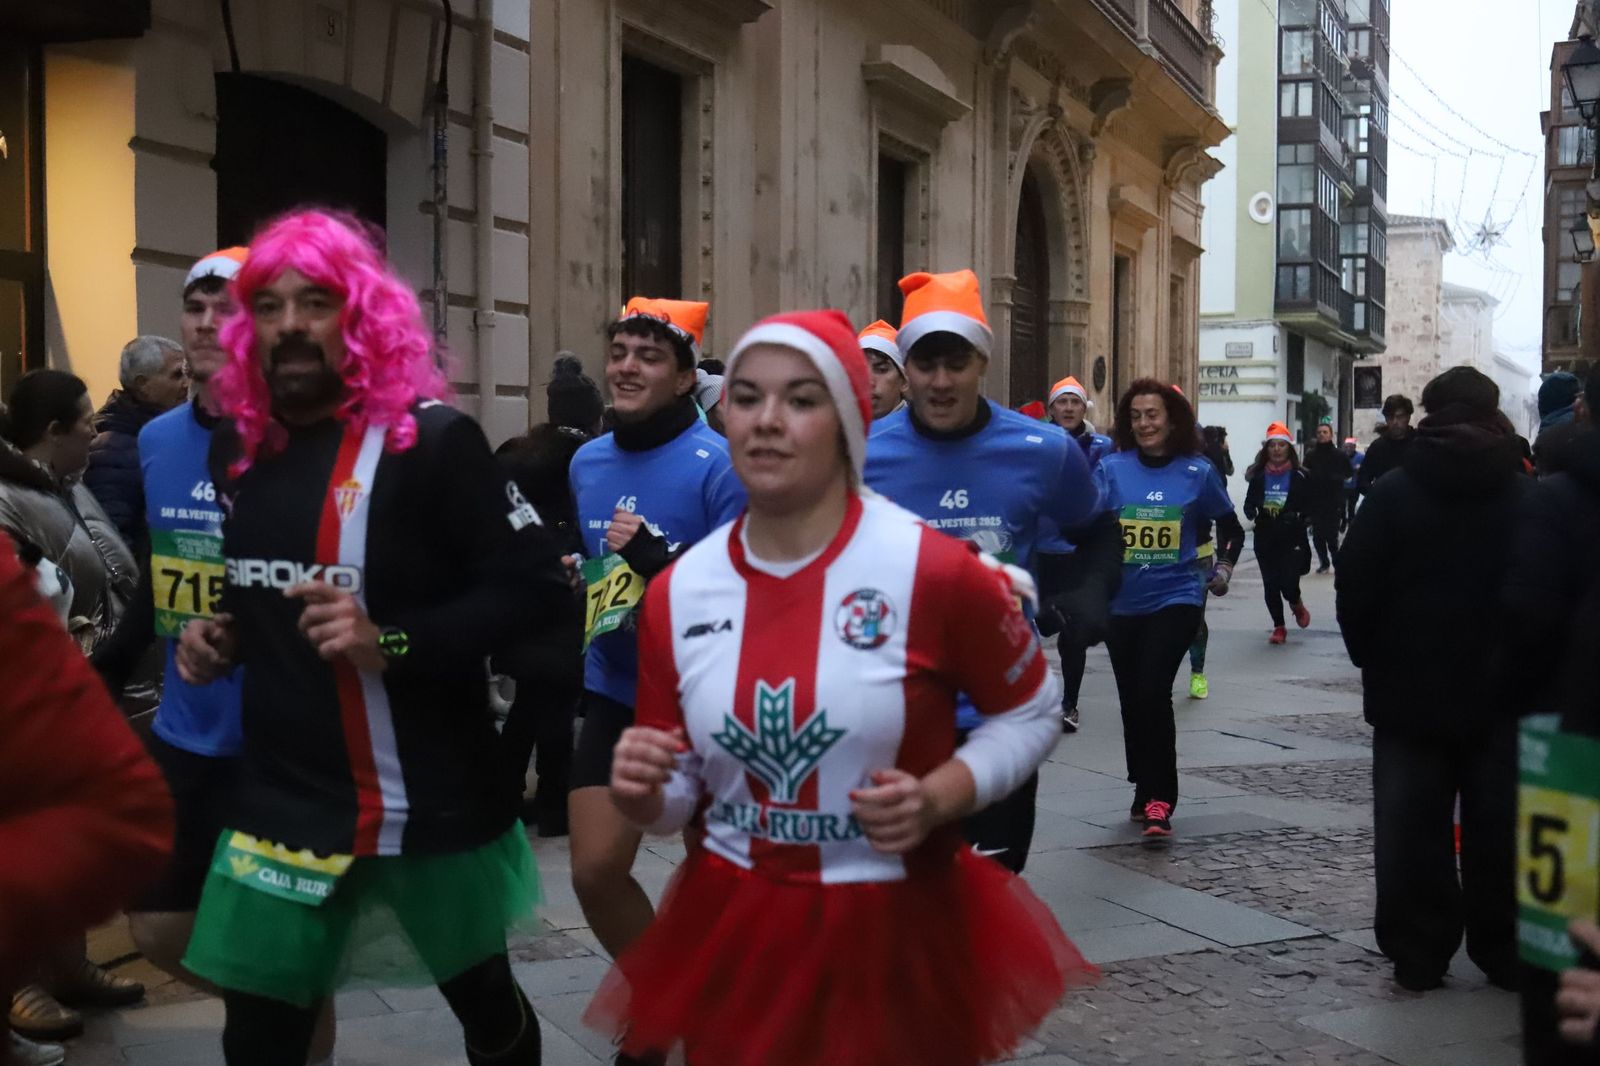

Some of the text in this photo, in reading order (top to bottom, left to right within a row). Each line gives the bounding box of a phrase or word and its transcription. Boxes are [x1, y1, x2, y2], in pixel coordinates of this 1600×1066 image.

[191, 481, 216, 502] 46
[940, 489, 969, 509] 46
[1146, 491, 1164, 501] 46
[616, 495, 637, 513] 46
[1122, 525, 1171, 549] 566
[225, 557, 362, 595] SIROKO
[161, 568, 224, 614] 715
[1529, 813, 1568, 905] 5
